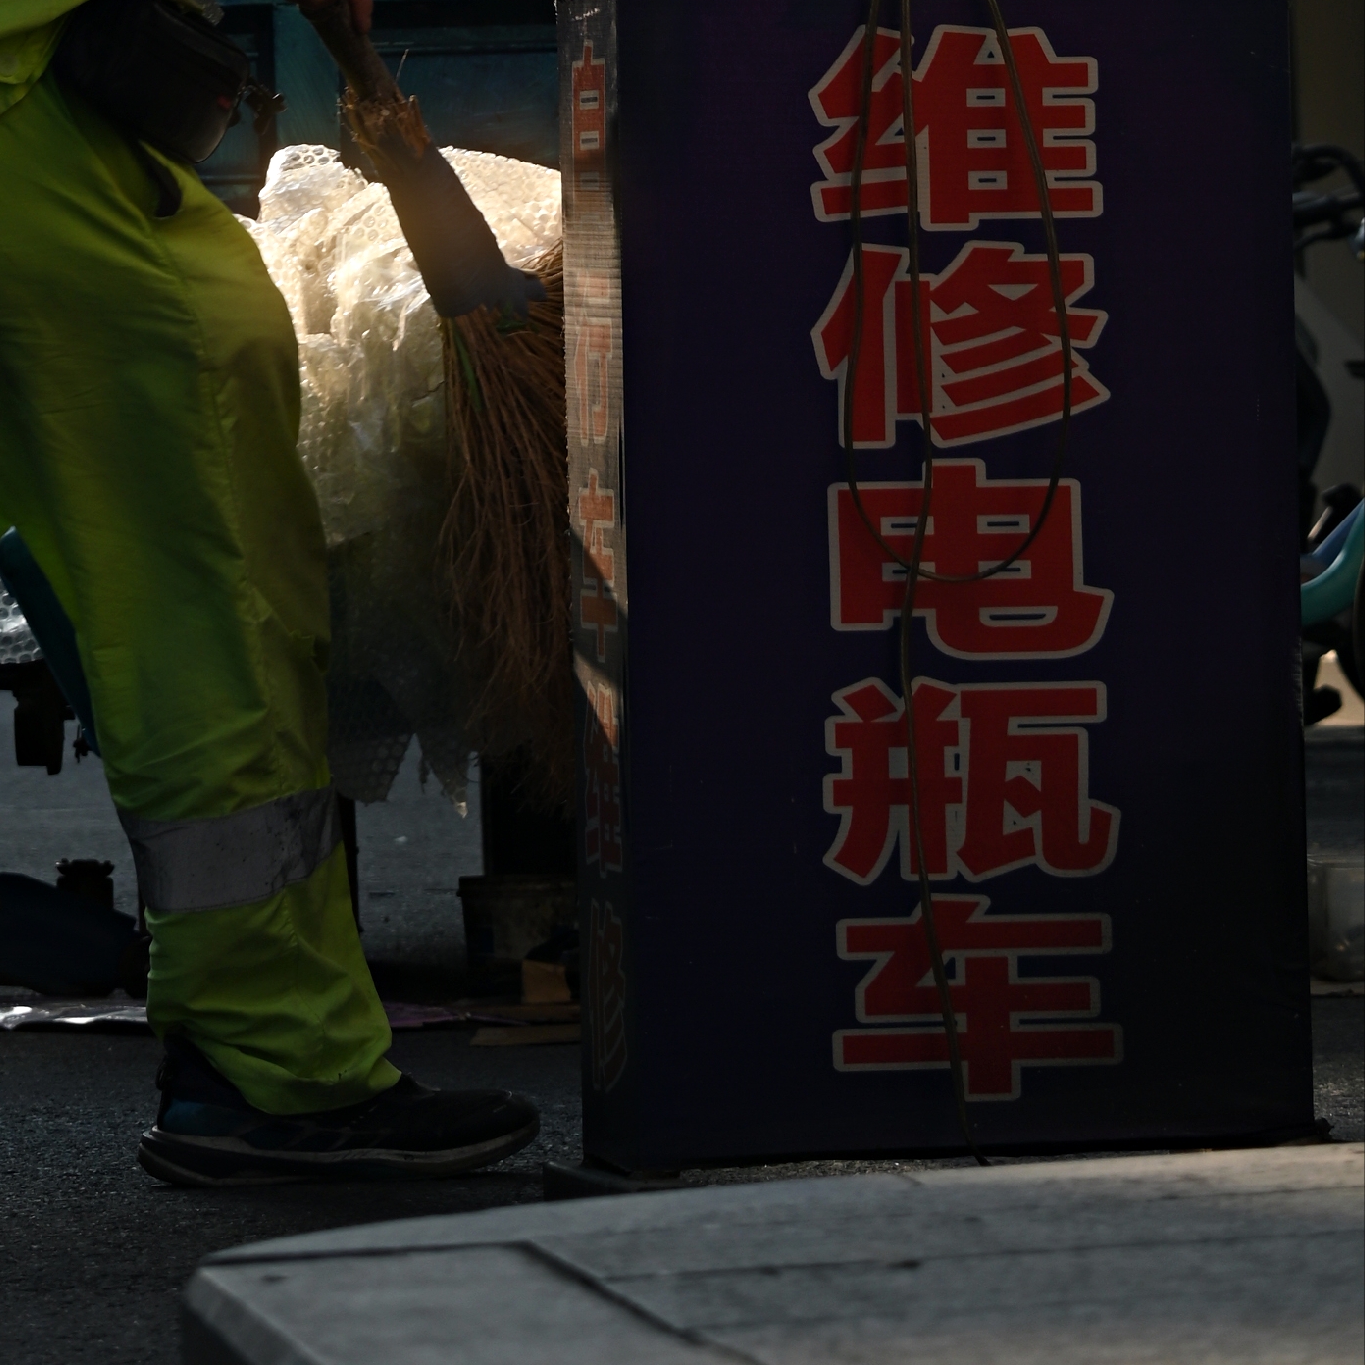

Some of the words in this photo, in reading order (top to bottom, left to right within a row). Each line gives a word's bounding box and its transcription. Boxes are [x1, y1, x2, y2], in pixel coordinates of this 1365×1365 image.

[571, 38, 628, 1094] 自行车维修
[808, 24, 1124, 1102] 维修电瓶车
